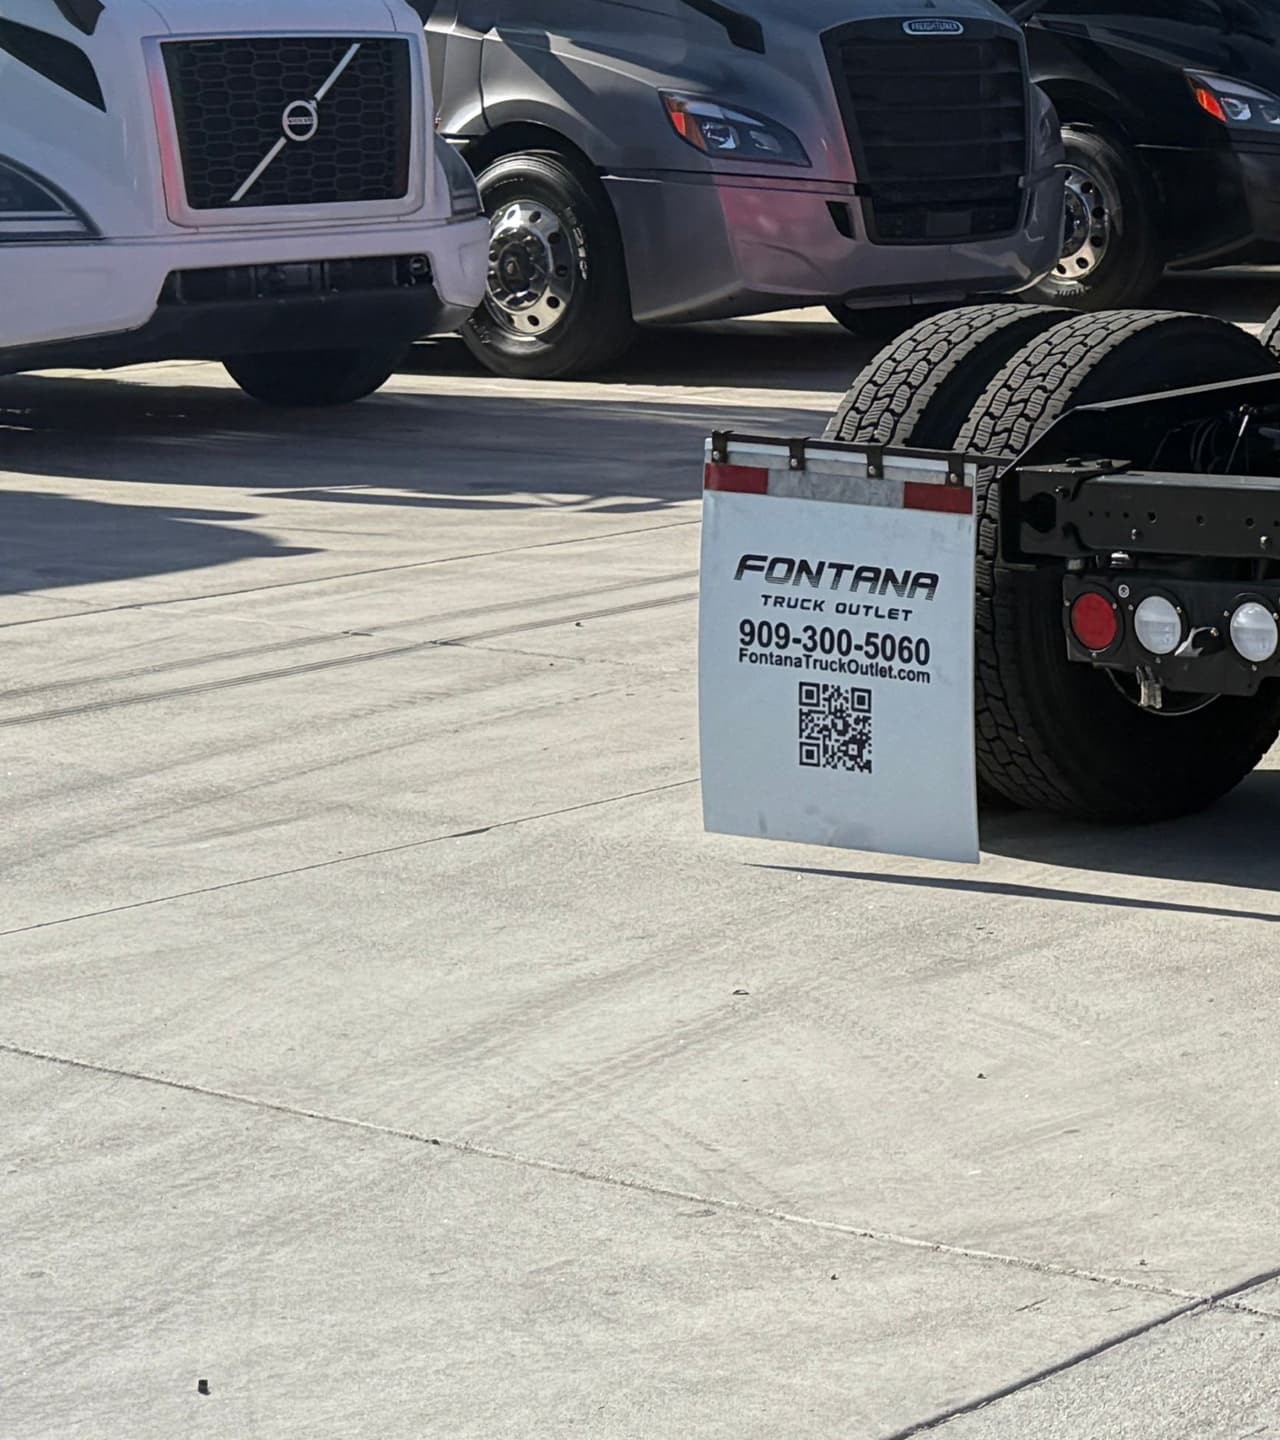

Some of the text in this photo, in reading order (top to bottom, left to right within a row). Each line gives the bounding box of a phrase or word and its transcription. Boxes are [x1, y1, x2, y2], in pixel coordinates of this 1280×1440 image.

[734, 553, 940, 600] FONTANA
[761, 594, 913, 622] TRUCK OUTLET
[739, 619, 931, 666] 909-300-5060
[738, 648, 931, 684] FontanaTruckOutlet.com
